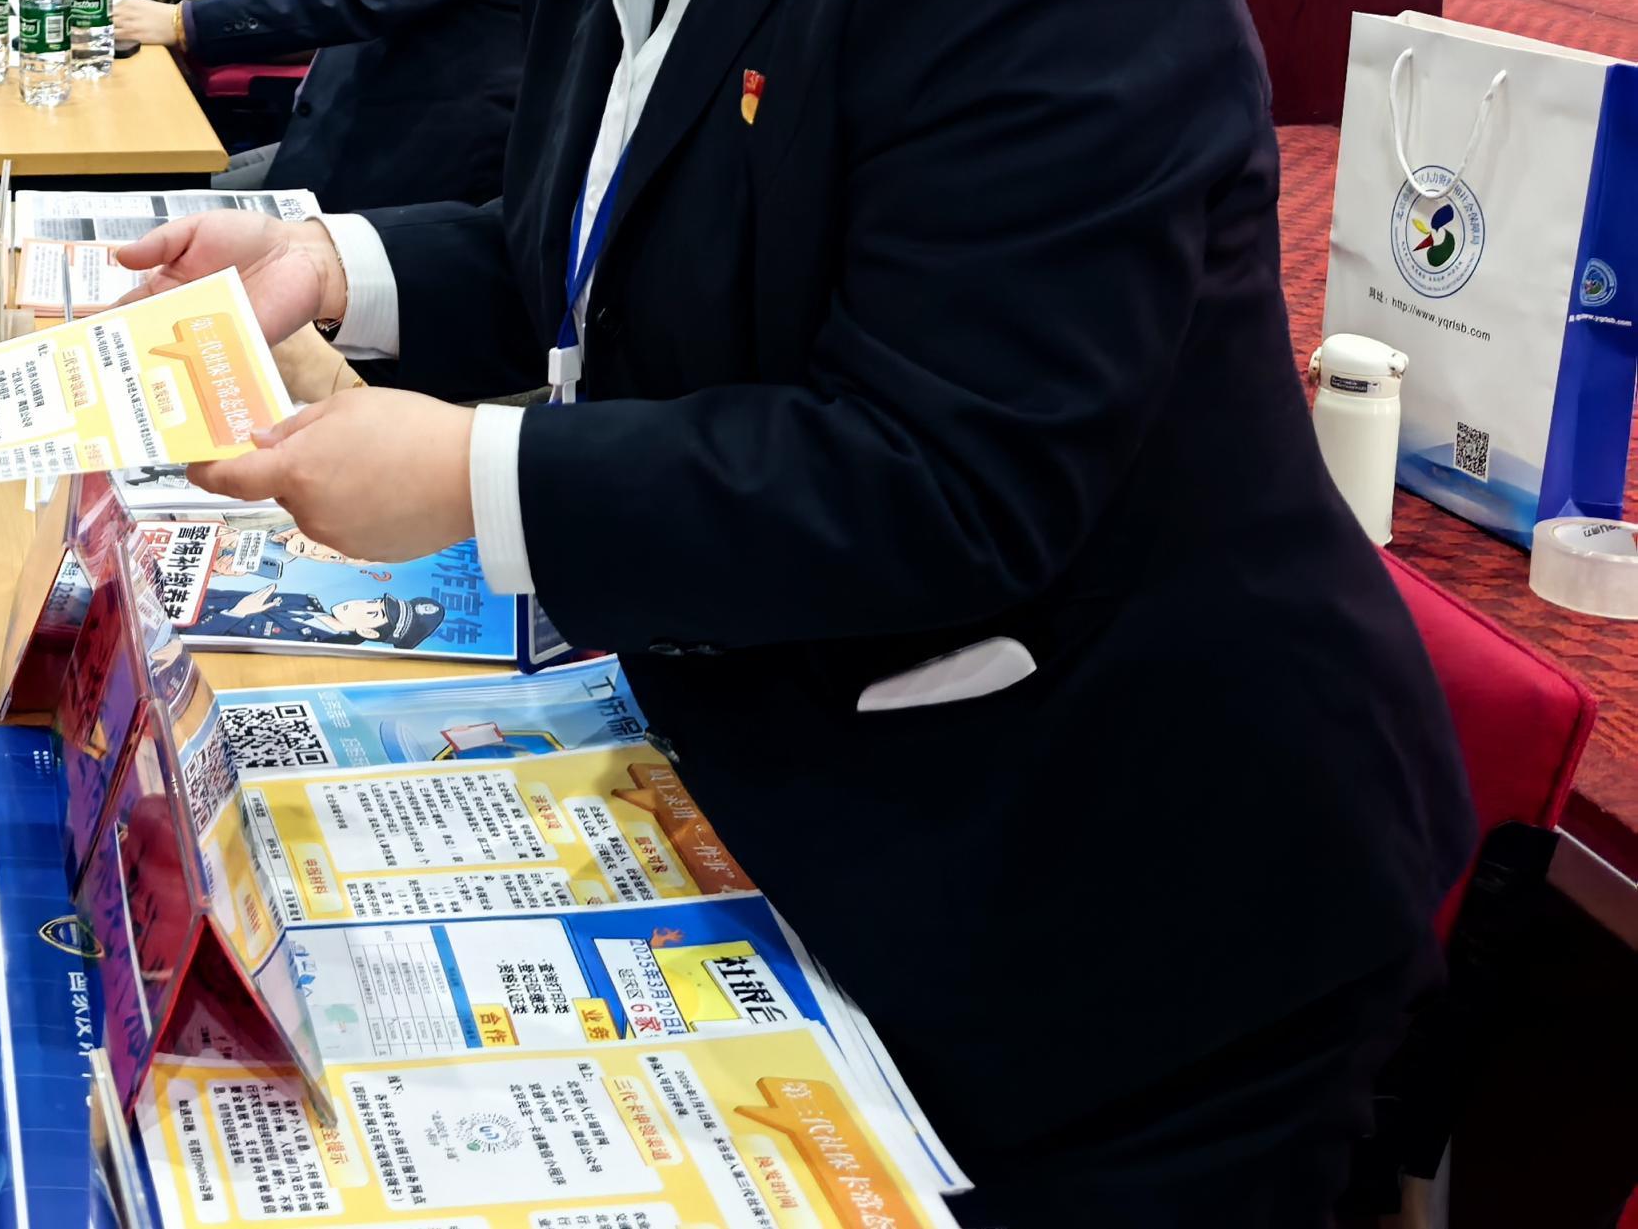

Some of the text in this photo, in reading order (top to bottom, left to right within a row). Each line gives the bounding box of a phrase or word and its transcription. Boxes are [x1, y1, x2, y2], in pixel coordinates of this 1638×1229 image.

[479, 1012, 507, 1043] 合作
[611, 1079, 672, 1160] 三代卡申领渠道
[751, 1156, 802, 1208] 换发时间
